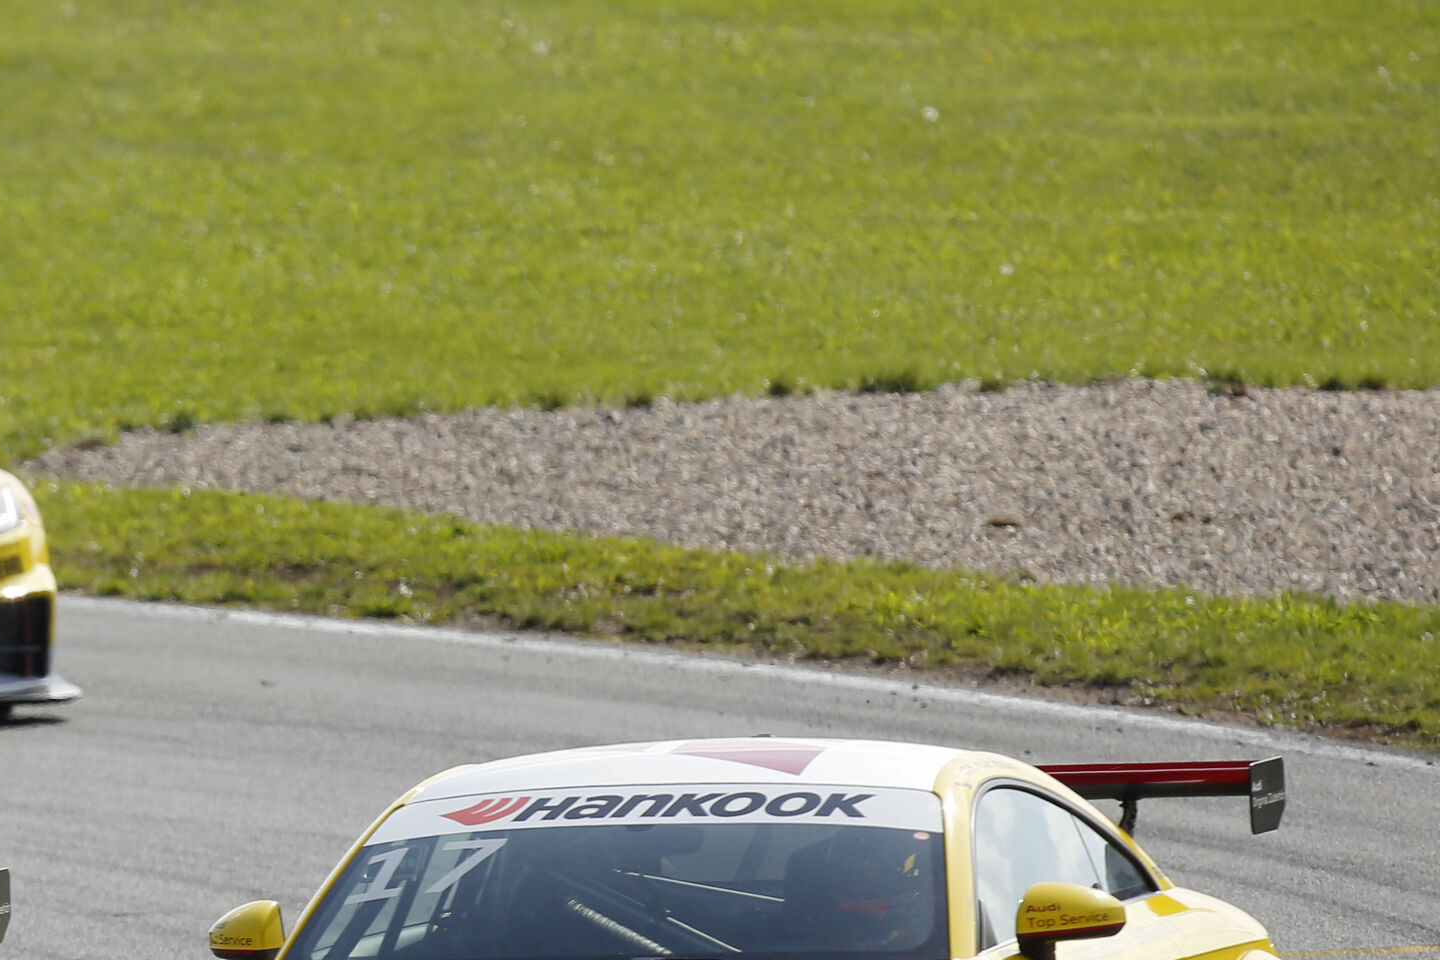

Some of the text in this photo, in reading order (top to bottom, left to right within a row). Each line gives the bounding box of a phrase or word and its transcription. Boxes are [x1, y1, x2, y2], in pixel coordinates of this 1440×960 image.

[349, 838, 509, 902] 17
[1025, 903, 1060, 913] Audi
[1026, 911, 1110, 929] Top Service
